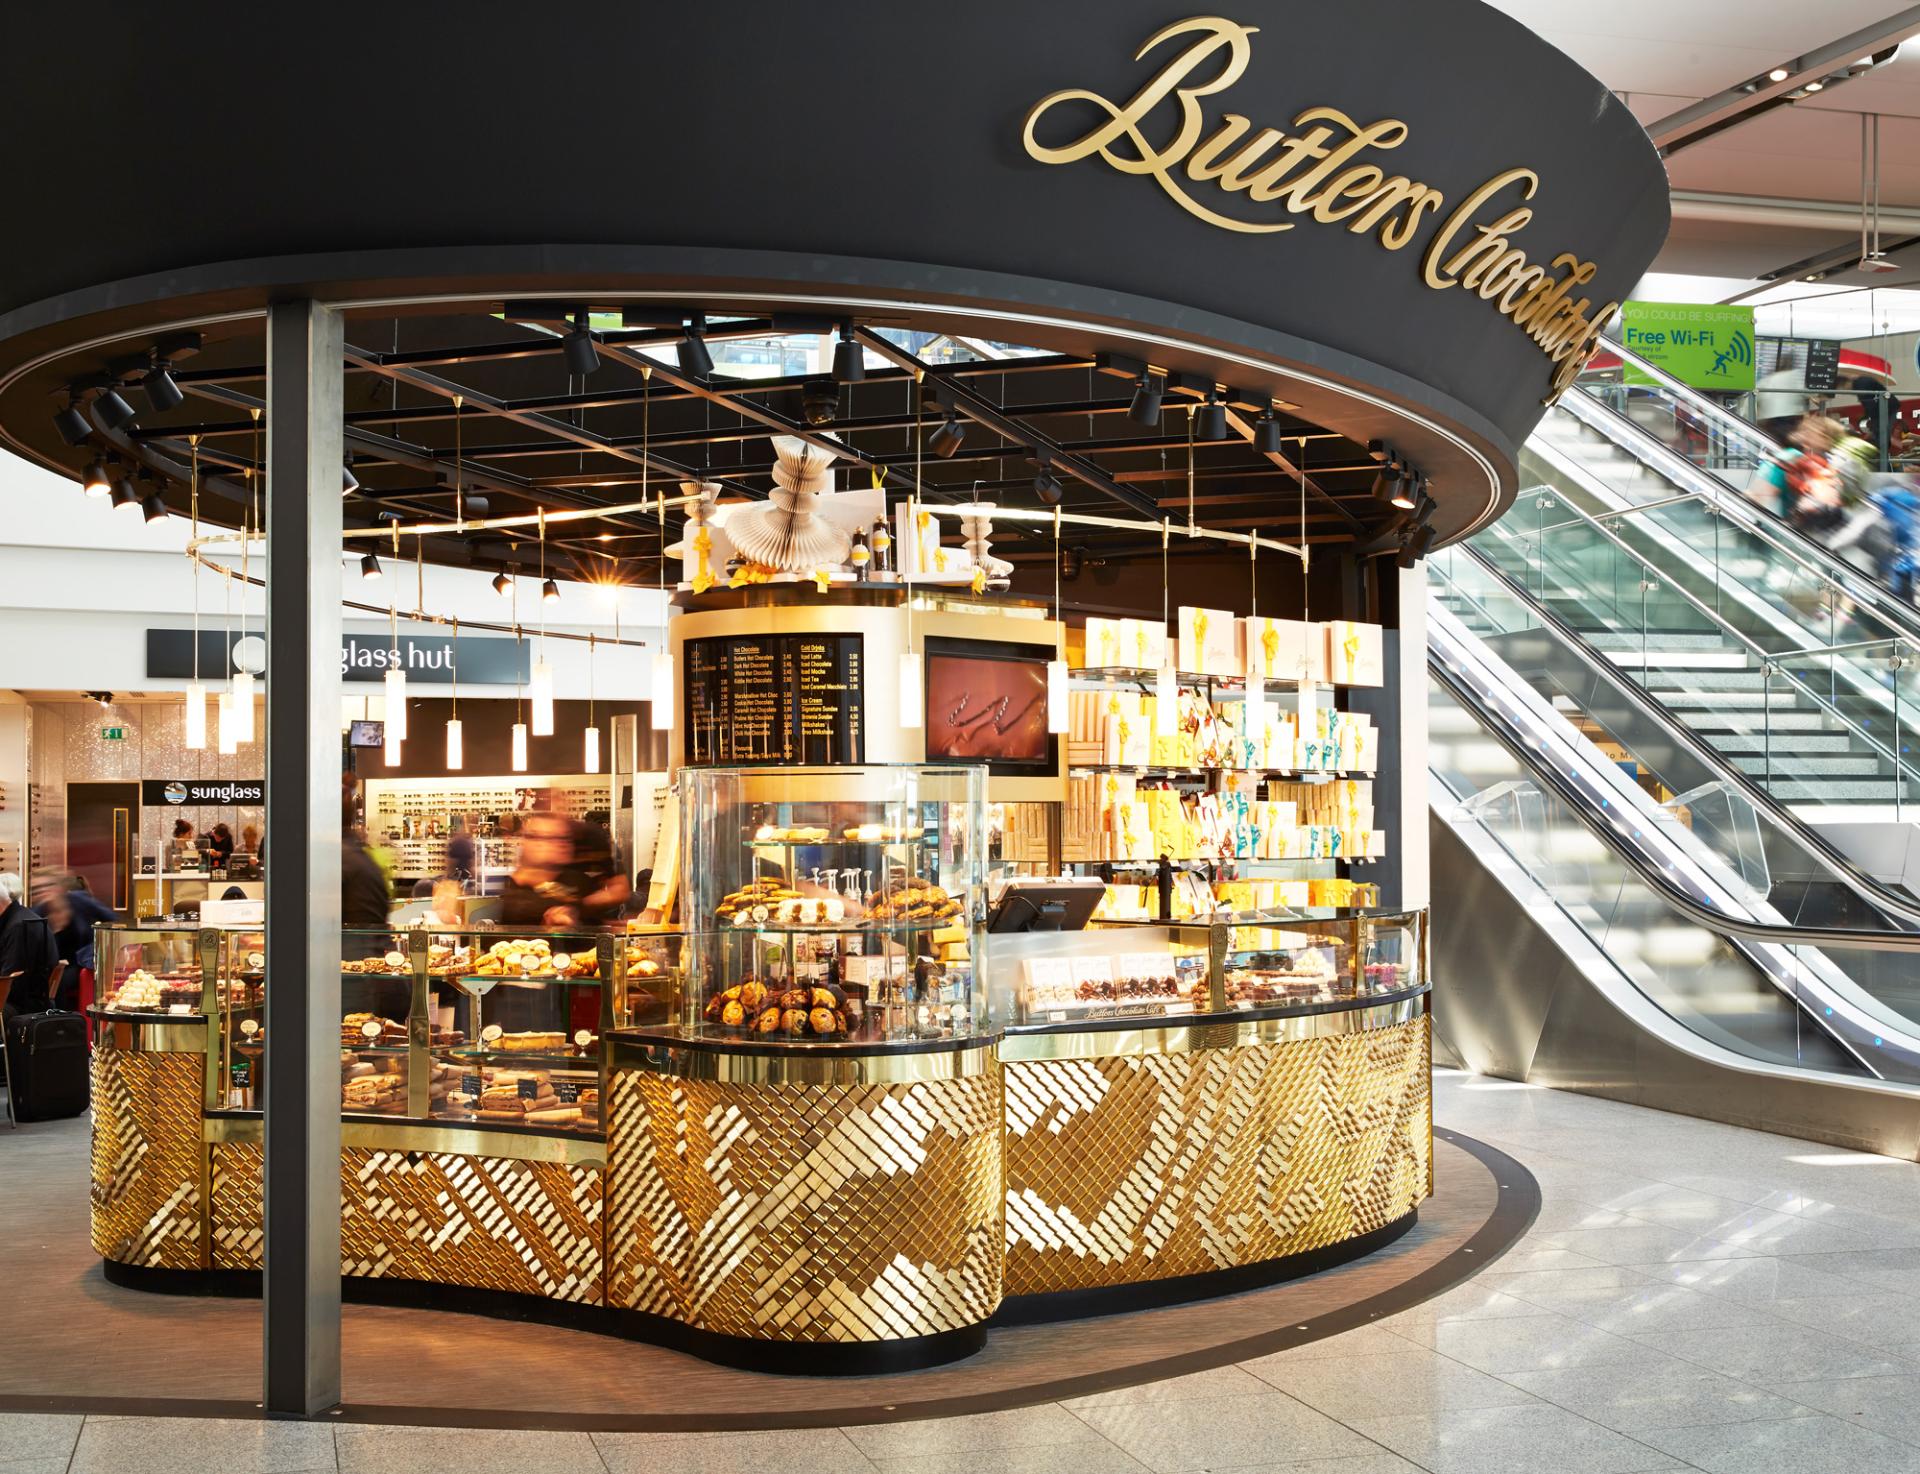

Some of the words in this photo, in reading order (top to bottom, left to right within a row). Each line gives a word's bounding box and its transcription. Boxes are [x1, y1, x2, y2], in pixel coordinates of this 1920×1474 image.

[1020, 16, 1444, 250] Butlers
[1420, 167, 1597, 362] Chocolate
[1628, 308, 1648, 319] YOU
[1650, 309, 1686, 321] COULD
[1689, 311, 1702, 321] BE
[1627, 328, 1665, 344] Free
[1670, 330, 1714, 346] Wi-Fi
[342, 640, 402, 674] glass
[409, 641, 454, 669] hut
[191, 783, 261, 803] sunglass
